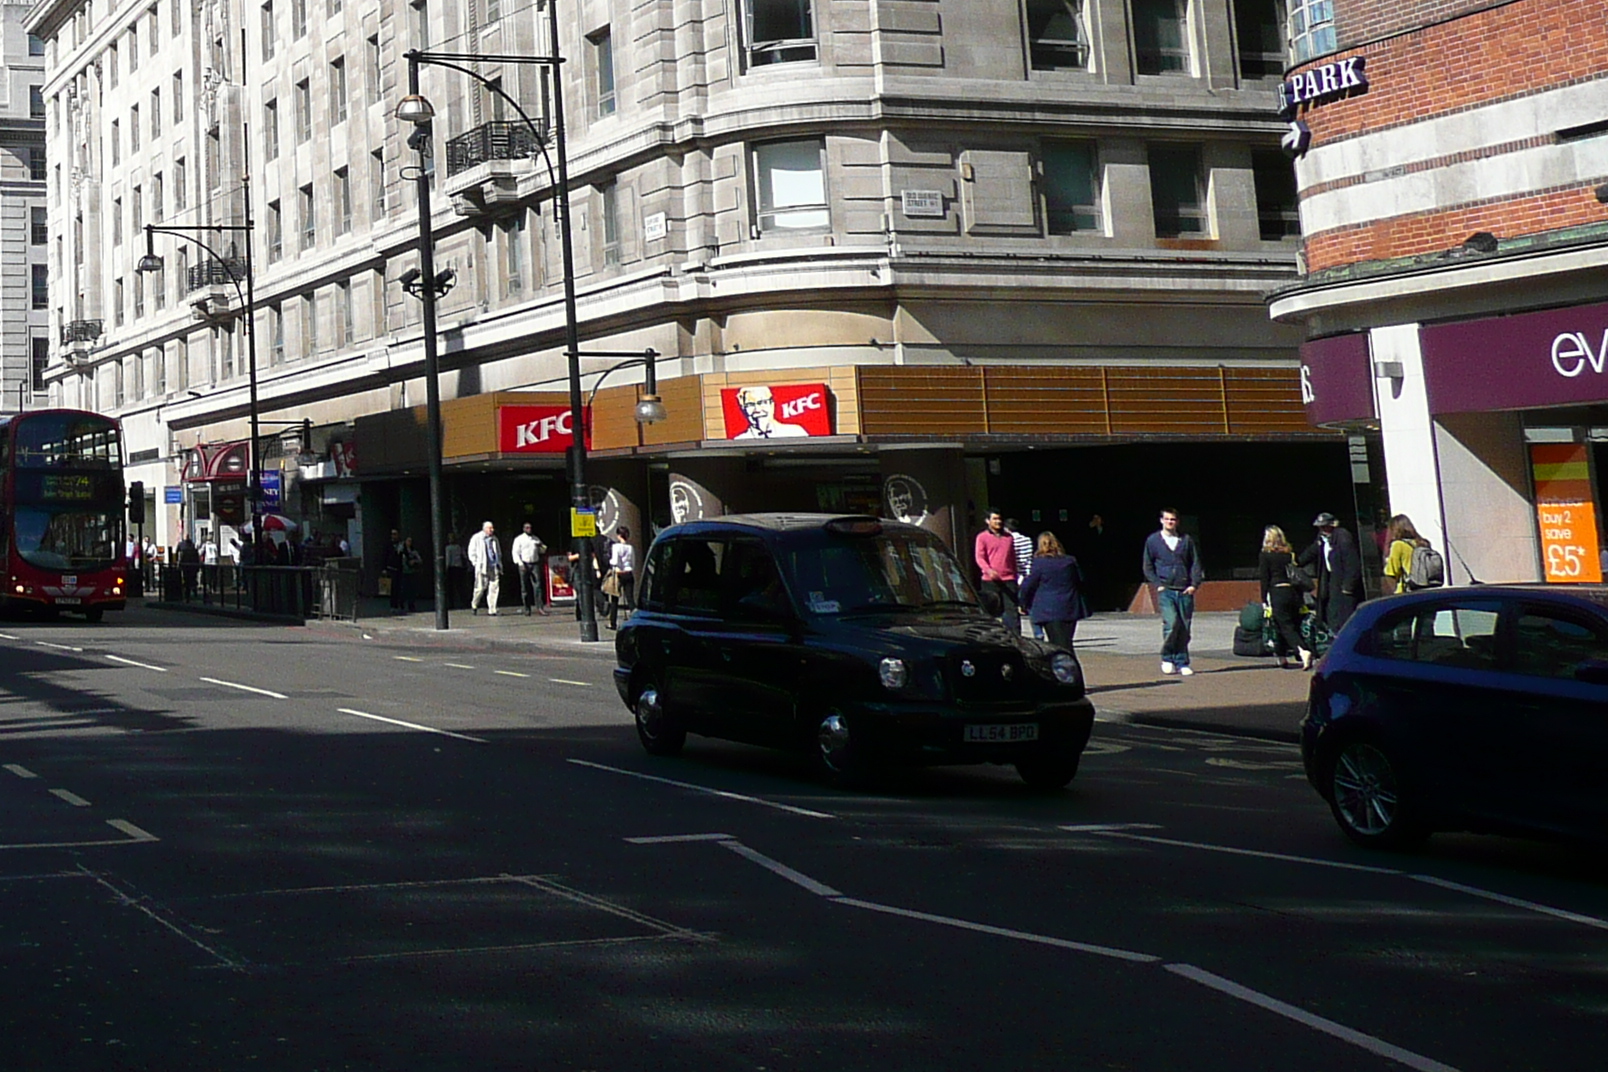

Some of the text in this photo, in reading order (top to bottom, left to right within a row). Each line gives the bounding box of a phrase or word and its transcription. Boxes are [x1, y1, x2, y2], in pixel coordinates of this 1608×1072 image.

[1290, 57, 1362, 103] PARK
[781, 392, 821, 419] KFC
[516, 410, 574, 449] KFC
[1542, 510, 1572, 527] buy 2
[1544, 528, 1572, 540] save
